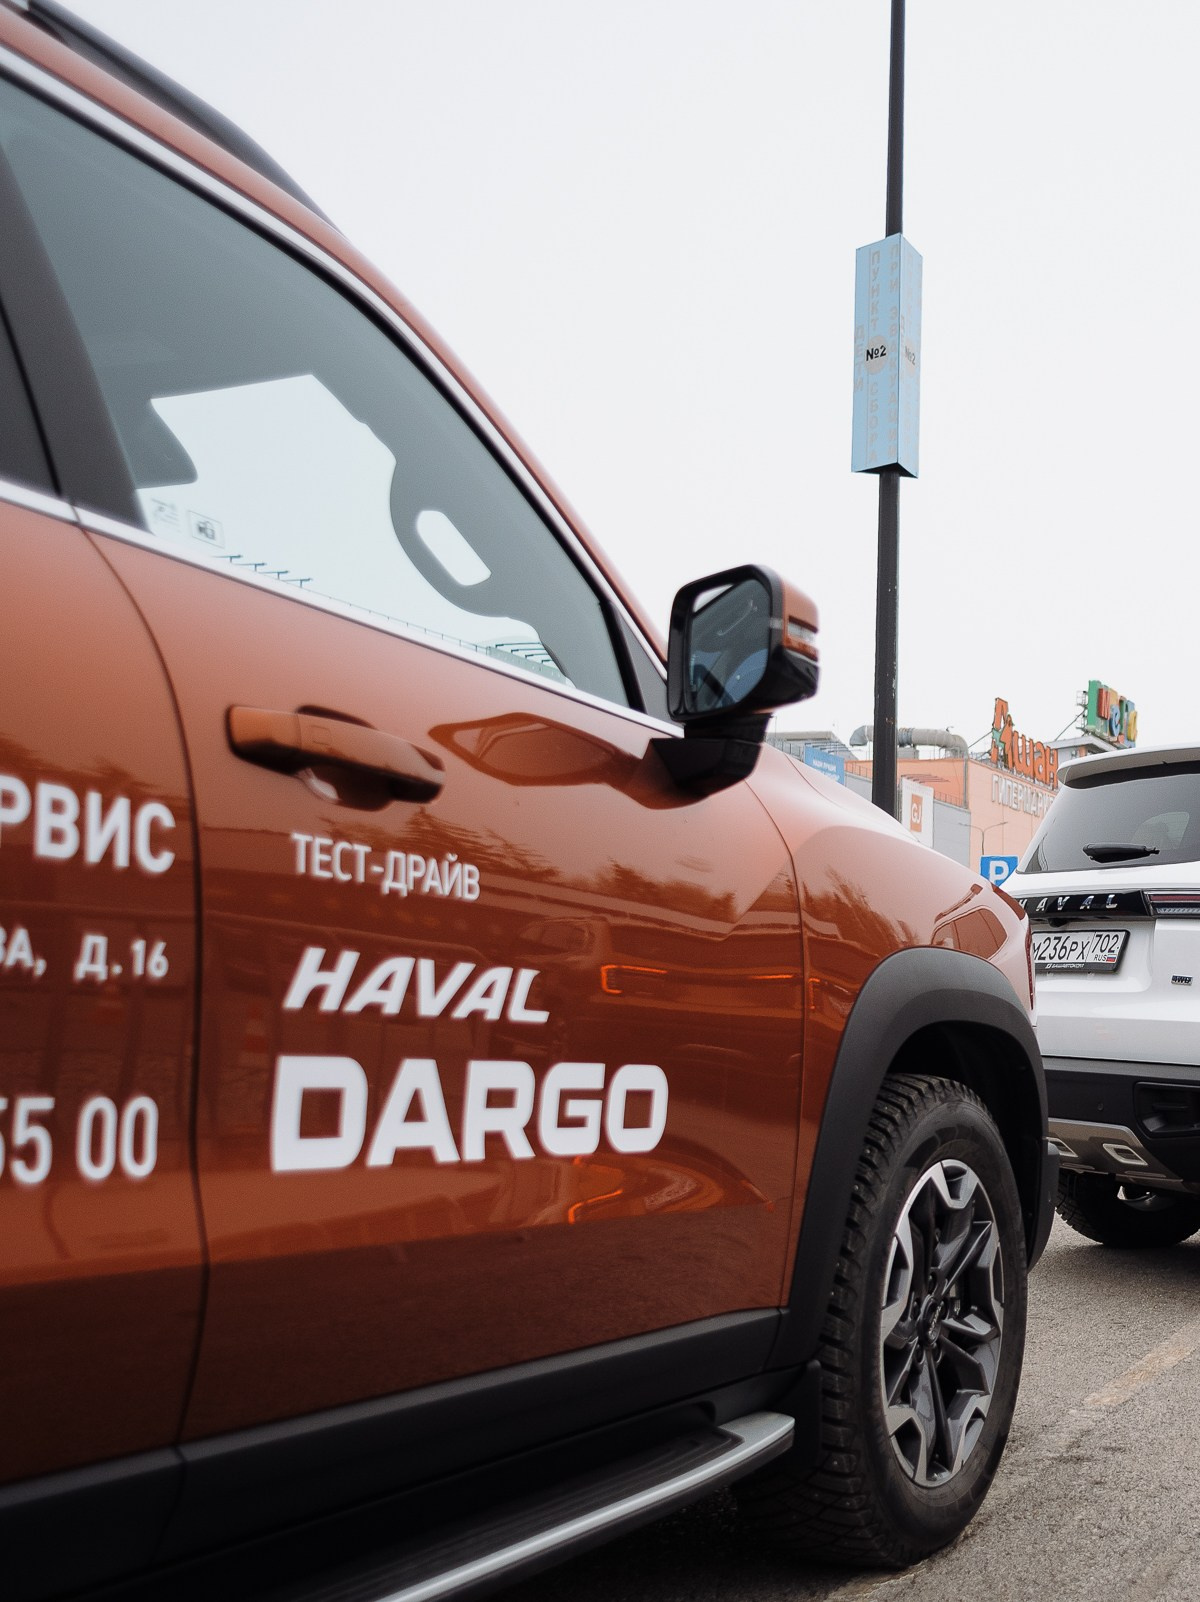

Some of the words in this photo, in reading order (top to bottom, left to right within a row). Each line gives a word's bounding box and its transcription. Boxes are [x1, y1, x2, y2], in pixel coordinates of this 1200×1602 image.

[865, 345, 887, 361] №2
[0, 774, 177, 874] РВИС
[992, 774, 1056, 818] ГИПЕРМАРК
[291, 832, 481, 901] ТЕСТ-ДРАЙВ
[989, 860, 1010, 885] P
[1092, 933, 1119, 954] 702
[283, 946, 551, 1024] HAVAL
[76, 1095, 160, 1180] 00
[272, 1054, 670, 1172] DARGO
